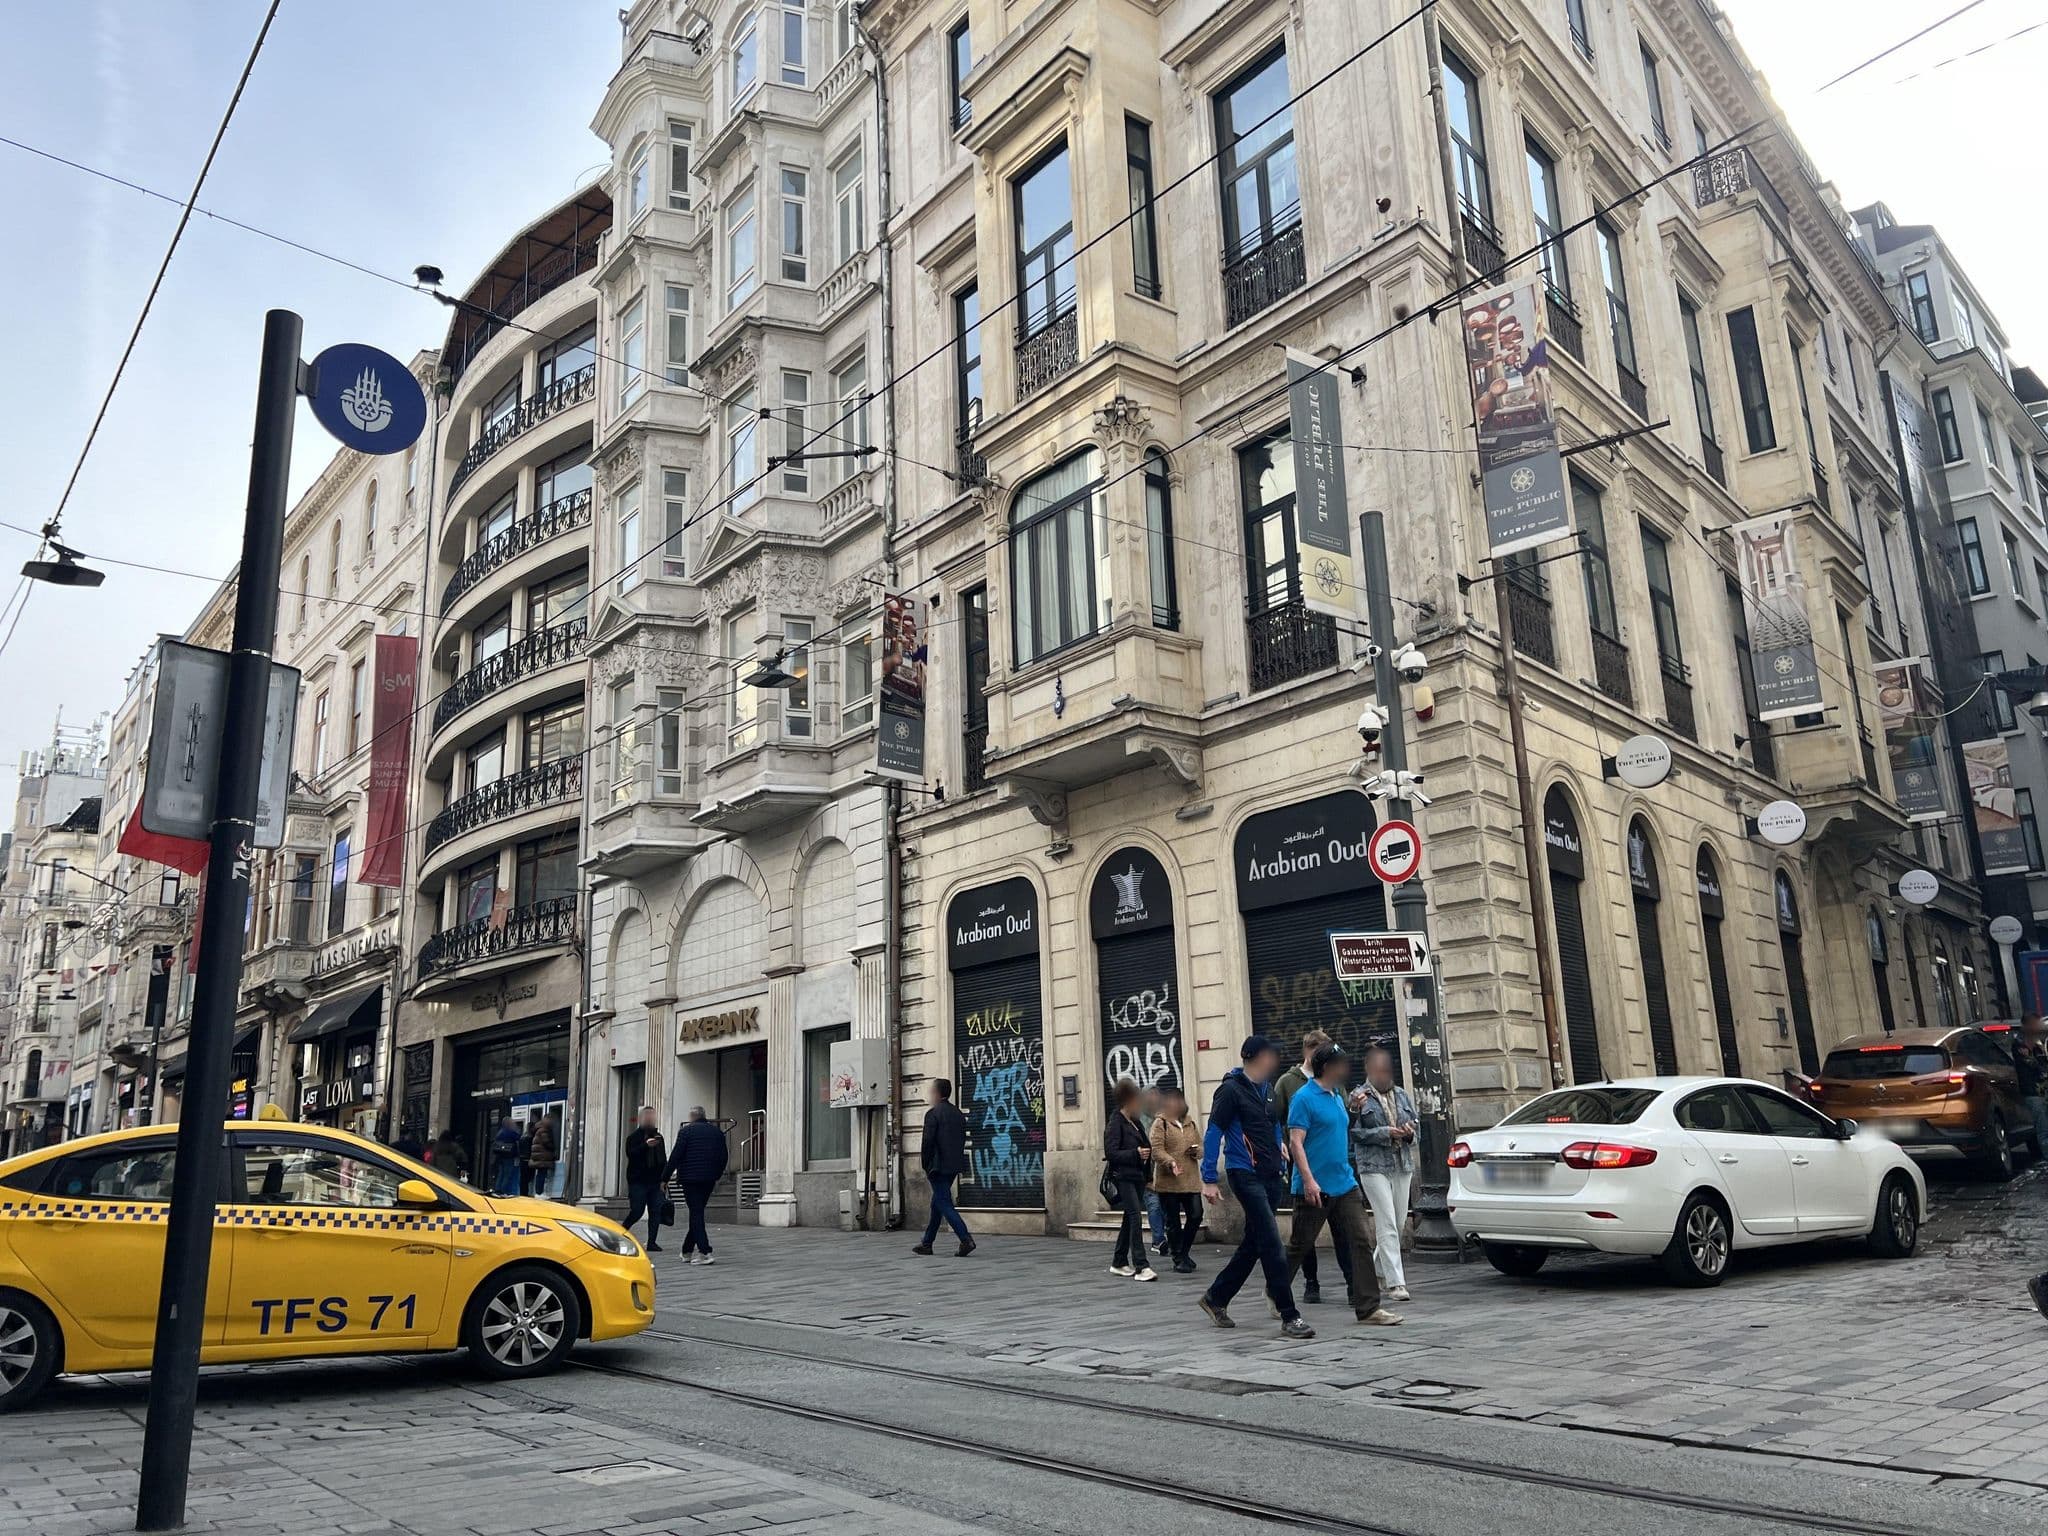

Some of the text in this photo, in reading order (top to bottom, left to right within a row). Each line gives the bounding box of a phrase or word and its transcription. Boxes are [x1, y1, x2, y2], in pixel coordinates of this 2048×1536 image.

[1309, 385, 1325, 472] PUBLIC
[1317, 478, 1329, 523] THE
[1517, 490, 1561, 510] PUBLIC
[1780, 675, 1816, 687] PUBLIC
[1636, 755, 1665, 764] PUBLIC
[1249, 832, 1368, 881] Arabian Oud
[956, 909, 1031, 946] Arabian Oud
[1341, 948, 1379, 957] Galatasaray
[1372, 955, 1394, 964] Turkish
[1362, 965, 1395, 973] Since 1481
[679, 1006, 759, 1043] AKBANK
[325, 1078, 353, 1107] LOYA
[251, 1294, 416, 1335] TFS 71
